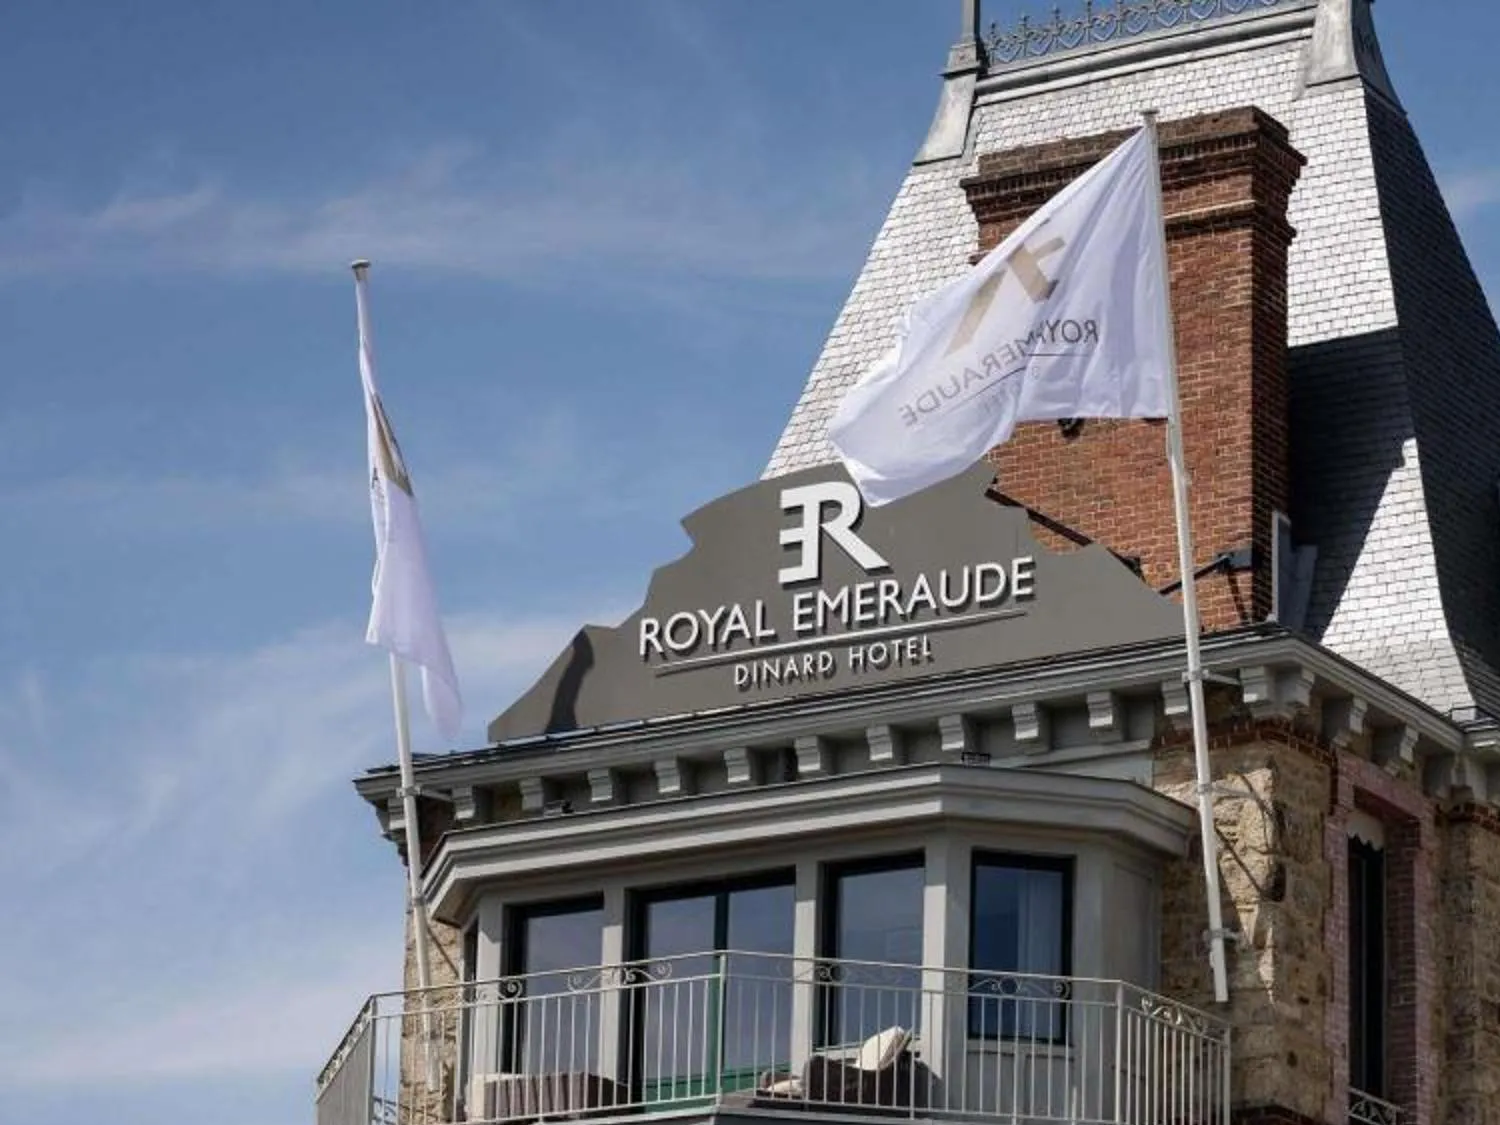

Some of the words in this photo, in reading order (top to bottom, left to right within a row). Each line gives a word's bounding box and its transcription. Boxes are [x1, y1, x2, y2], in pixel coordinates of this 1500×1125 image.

[639, 599, 776, 660] ROYAL
[792, 555, 1037, 632] EMERAUDE
[734, 648, 834, 688] DINARD
[847, 634, 933, 668] HOTEL
